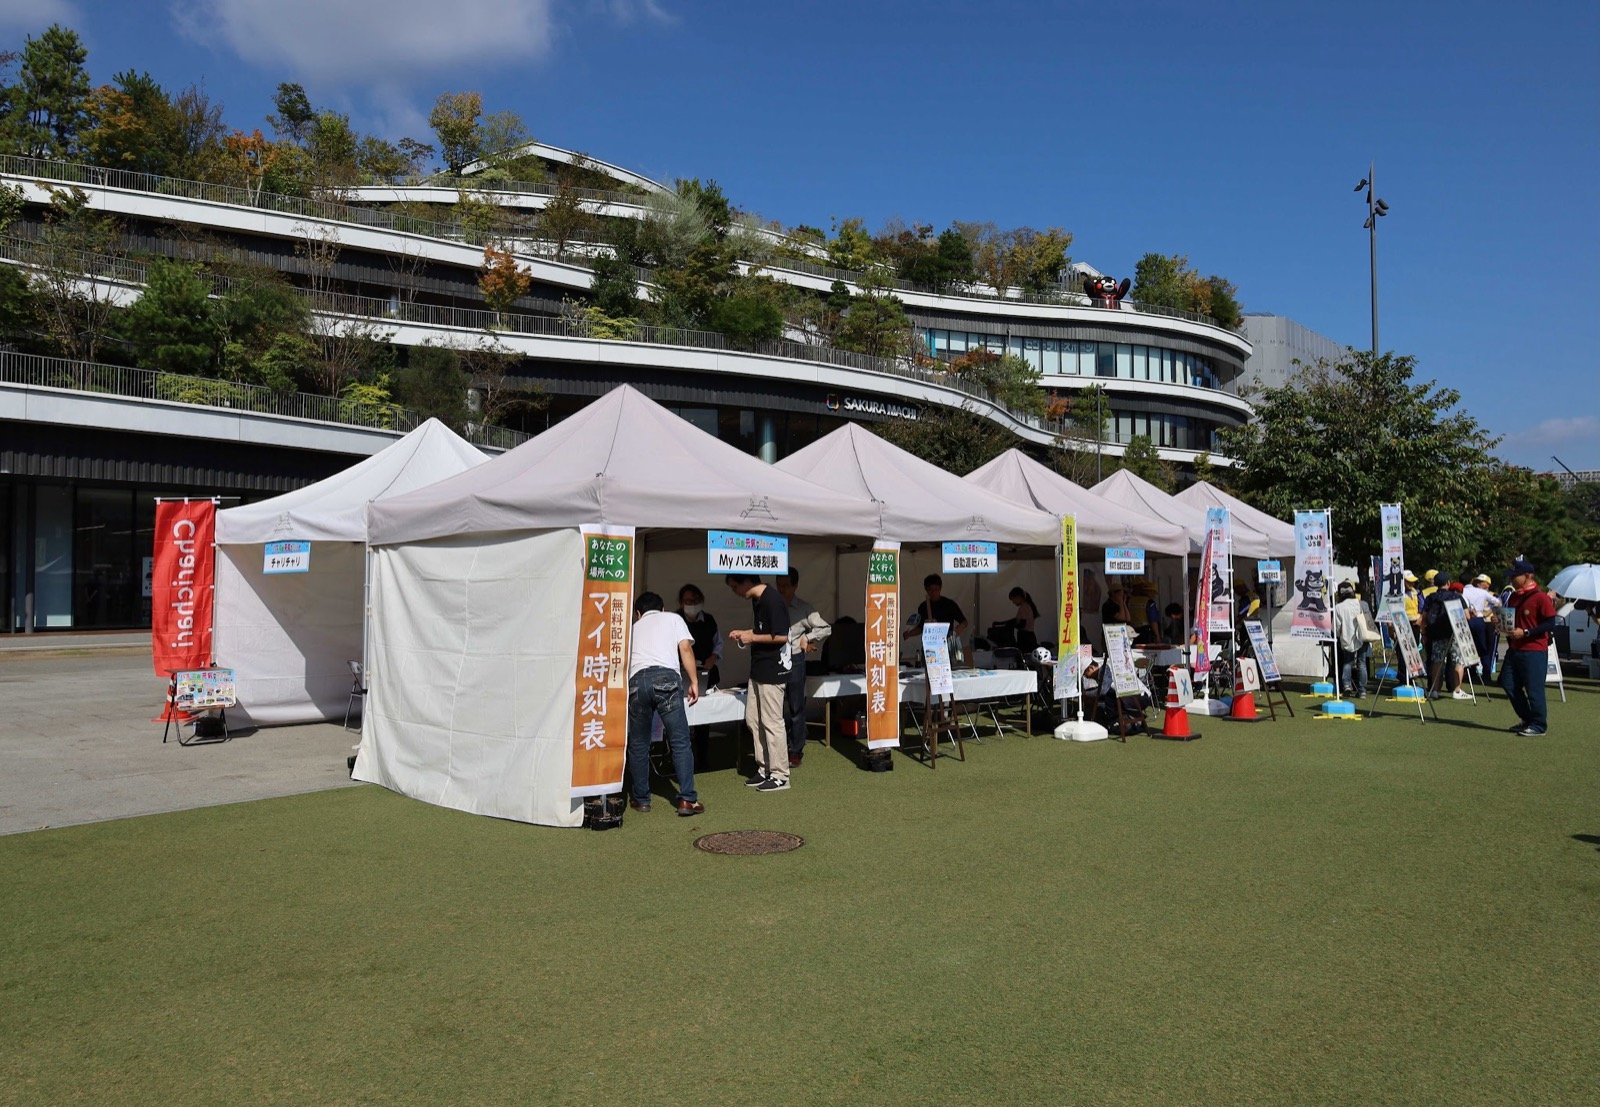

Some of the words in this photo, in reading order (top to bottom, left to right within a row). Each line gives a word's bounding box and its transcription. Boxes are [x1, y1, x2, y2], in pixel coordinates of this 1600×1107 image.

[843, 397, 886, 415] SAKURA
[887, 404, 917, 420] MACHI
[591, 538, 626, 551] あなたの
[271, 556, 301, 568] チャリチャリ
[591, 552, 624, 566] よく行く
[719, 553, 733, 570] My
[736, 553, 779, 569] バス時刻表
[870, 552, 894, 562] あなたの
[589, 566, 625, 579] 場所への
[870, 563, 893, 572] よく行く
[870, 593, 886, 714] マイ時刻表
[580, 592, 610, 751] マイ時刻表
